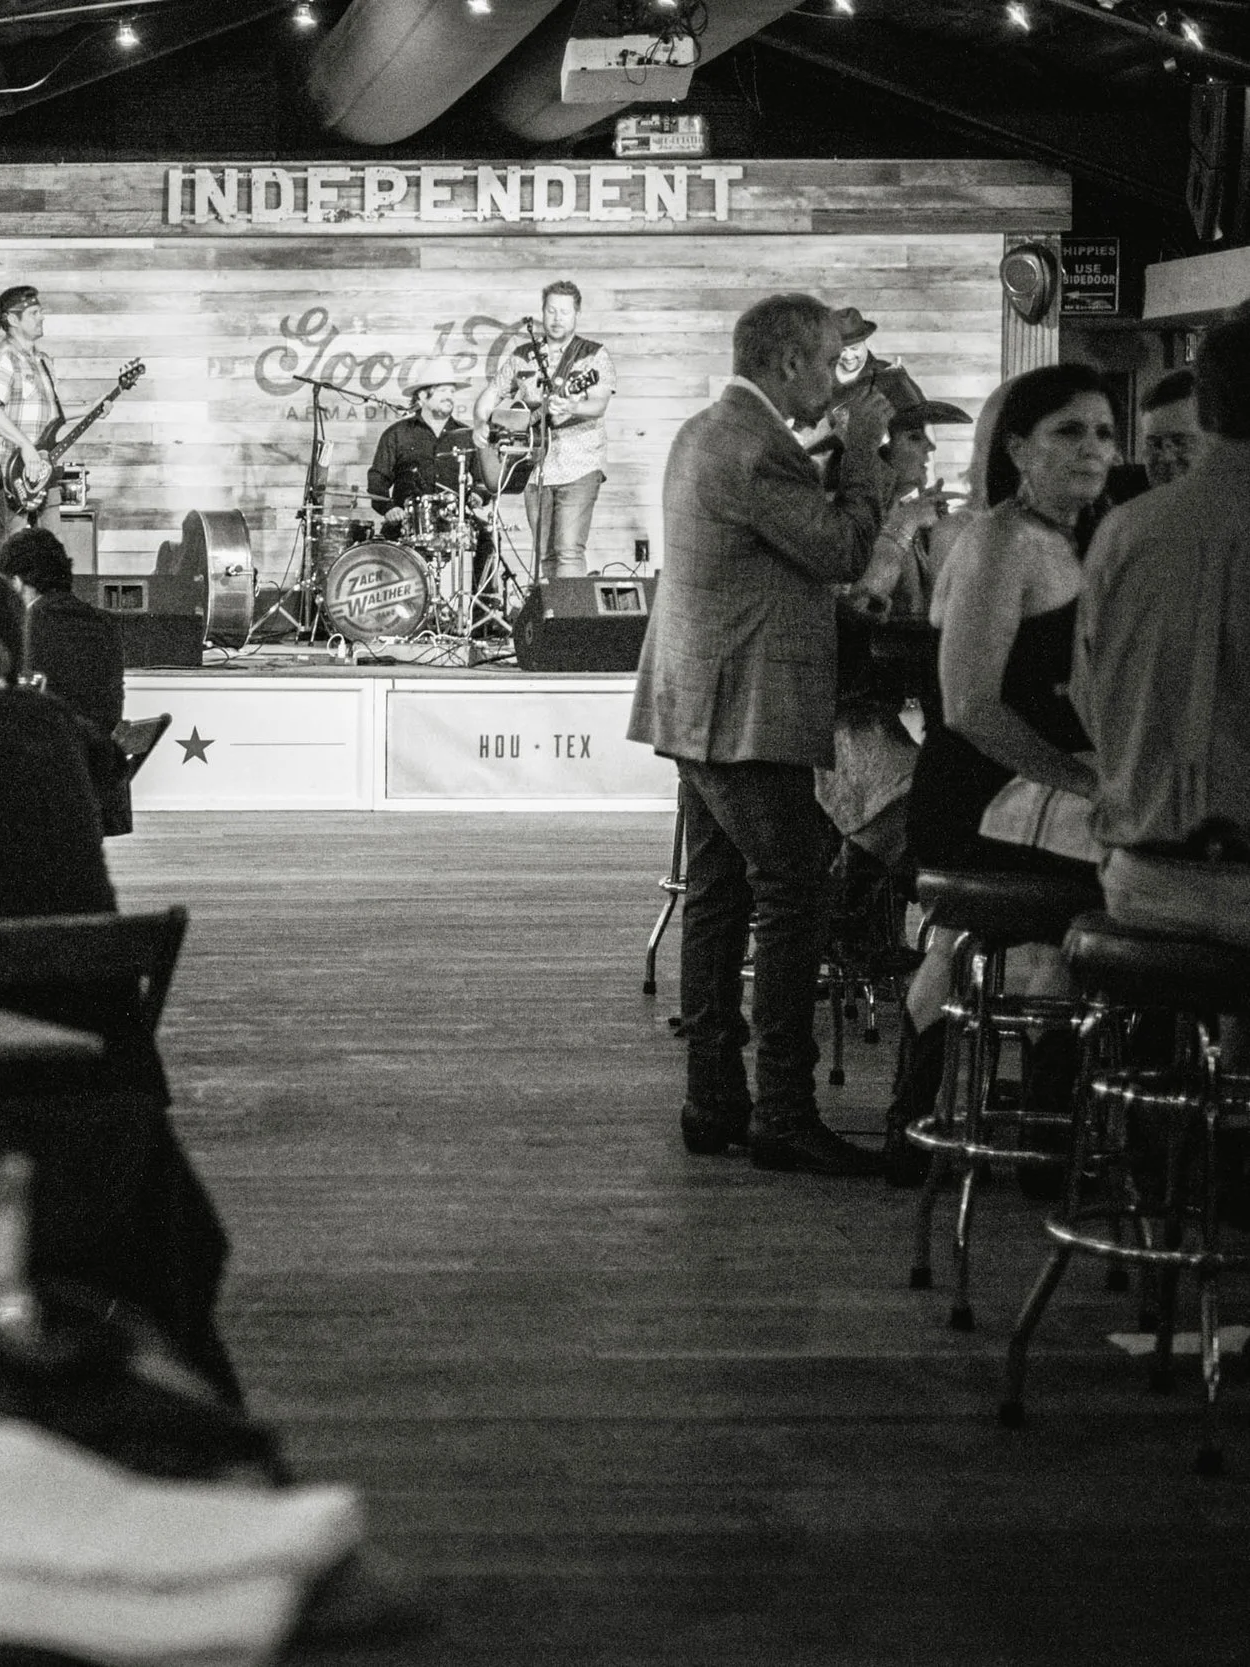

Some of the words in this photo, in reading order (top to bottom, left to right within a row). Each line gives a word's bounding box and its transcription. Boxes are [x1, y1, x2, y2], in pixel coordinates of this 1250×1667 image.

[167, 165, 744, 224] INDEPENDENT
[1062, 246, 1116, 256] HIPPIES
[1075, 263, 1102, 273] USE
[348, 569, 385, 594] ZACK
[347, 583, 412, 618] WALTHER
[479, 734, 520, 759] HOU
[553, 734, 591, 759] TEX
